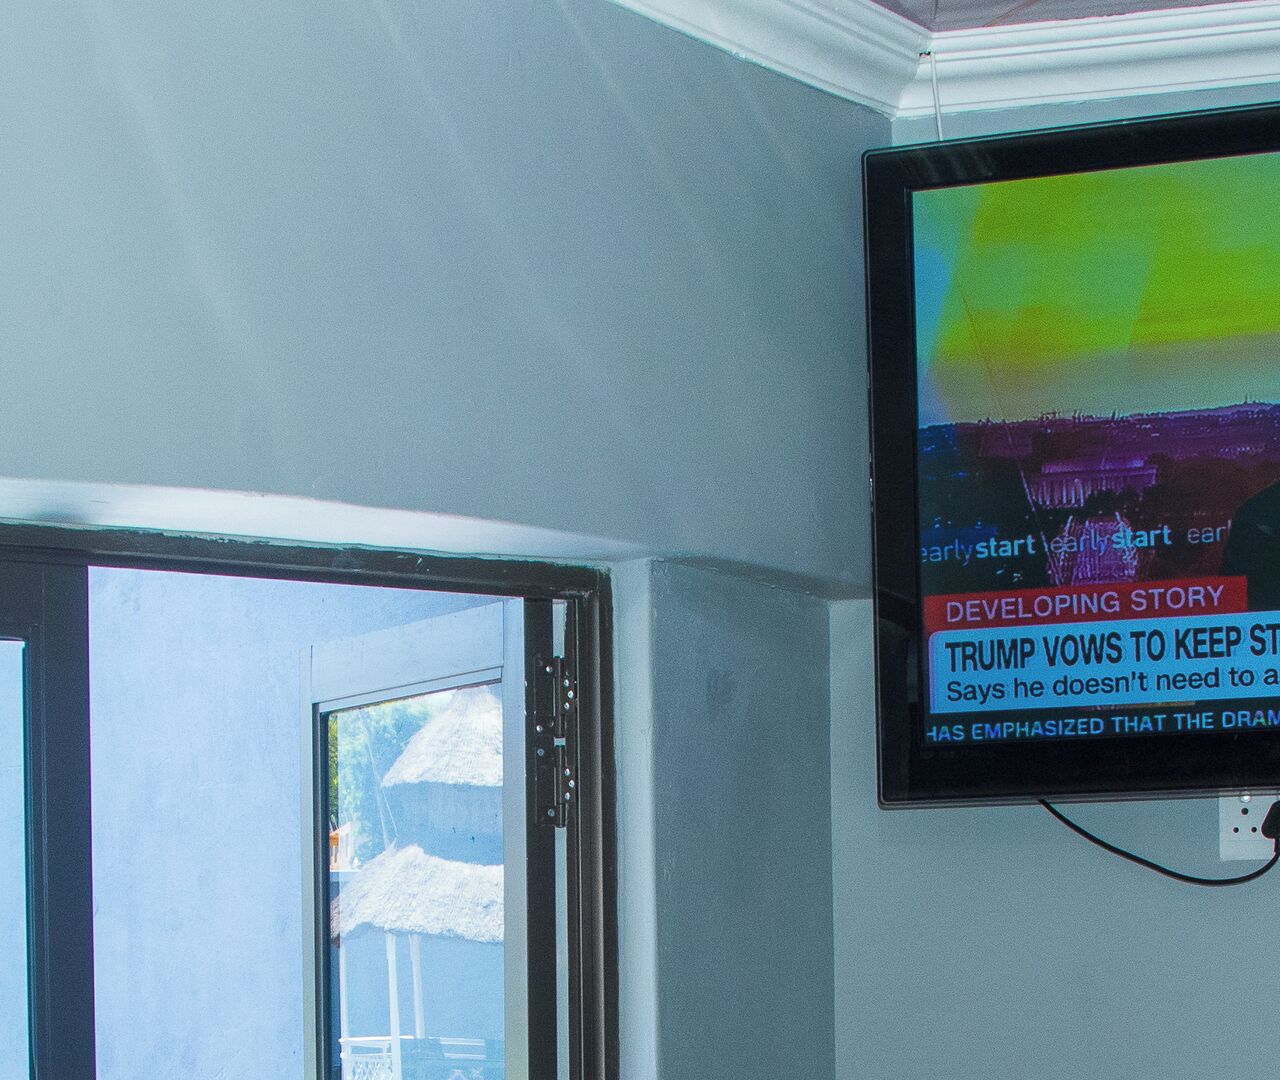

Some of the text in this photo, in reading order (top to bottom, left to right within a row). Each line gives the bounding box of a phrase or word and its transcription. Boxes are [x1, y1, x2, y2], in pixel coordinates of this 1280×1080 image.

[946, 584, 1225, 623] DEVELOPING STORY
[945, 636, 1036, 672] TRUMP
[1042, 631, 1123, 668] VOWS
[1129, 629, 1166, 662] TO
[1175, 625, 1242, 660] KEEP
[946, 681, 1005, 705] Says
[1013, 677, 1044, 698] he
[1052, 671, 1148, 696] doesn't
[1156, 667, 1220, 691] need
[1228, 666, 1255, 687] to
[971, 717, 1104, 740] EMPHASIZED
[1111, 713, 1167, 733] THAT
[1173, 711, 1215, 731] THE
